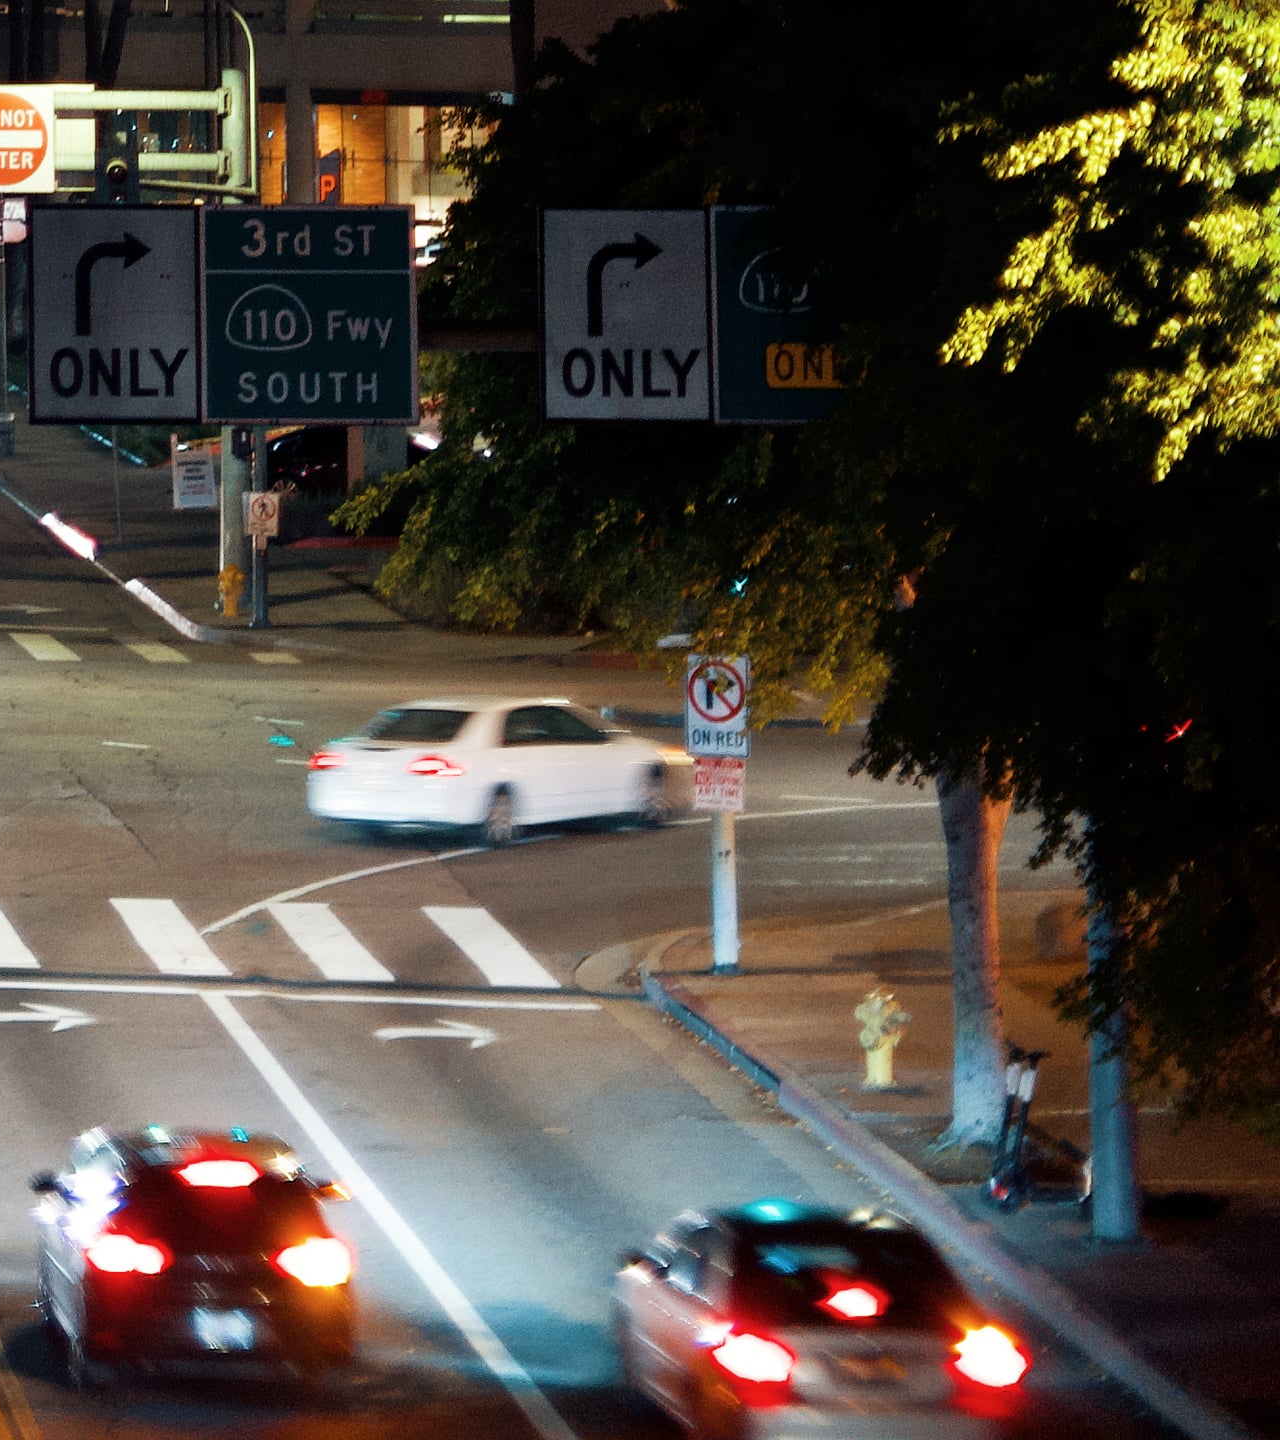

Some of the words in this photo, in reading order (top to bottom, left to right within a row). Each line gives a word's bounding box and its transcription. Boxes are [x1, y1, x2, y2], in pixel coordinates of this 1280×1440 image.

[0, 109, 36, 126] NOT
[241, 218, 312, 258] 3rd
[334, 224, 376, 257] ST
[242, 308, 297, 342] 110
[326, 310, 393, 349] Fwy
[50, 348, 188, 397] ONLY
[238, 371, 378, 404] SOUTH
[562, 347, 701, 397] ONLY
[692, 729, 711, 746] ON
